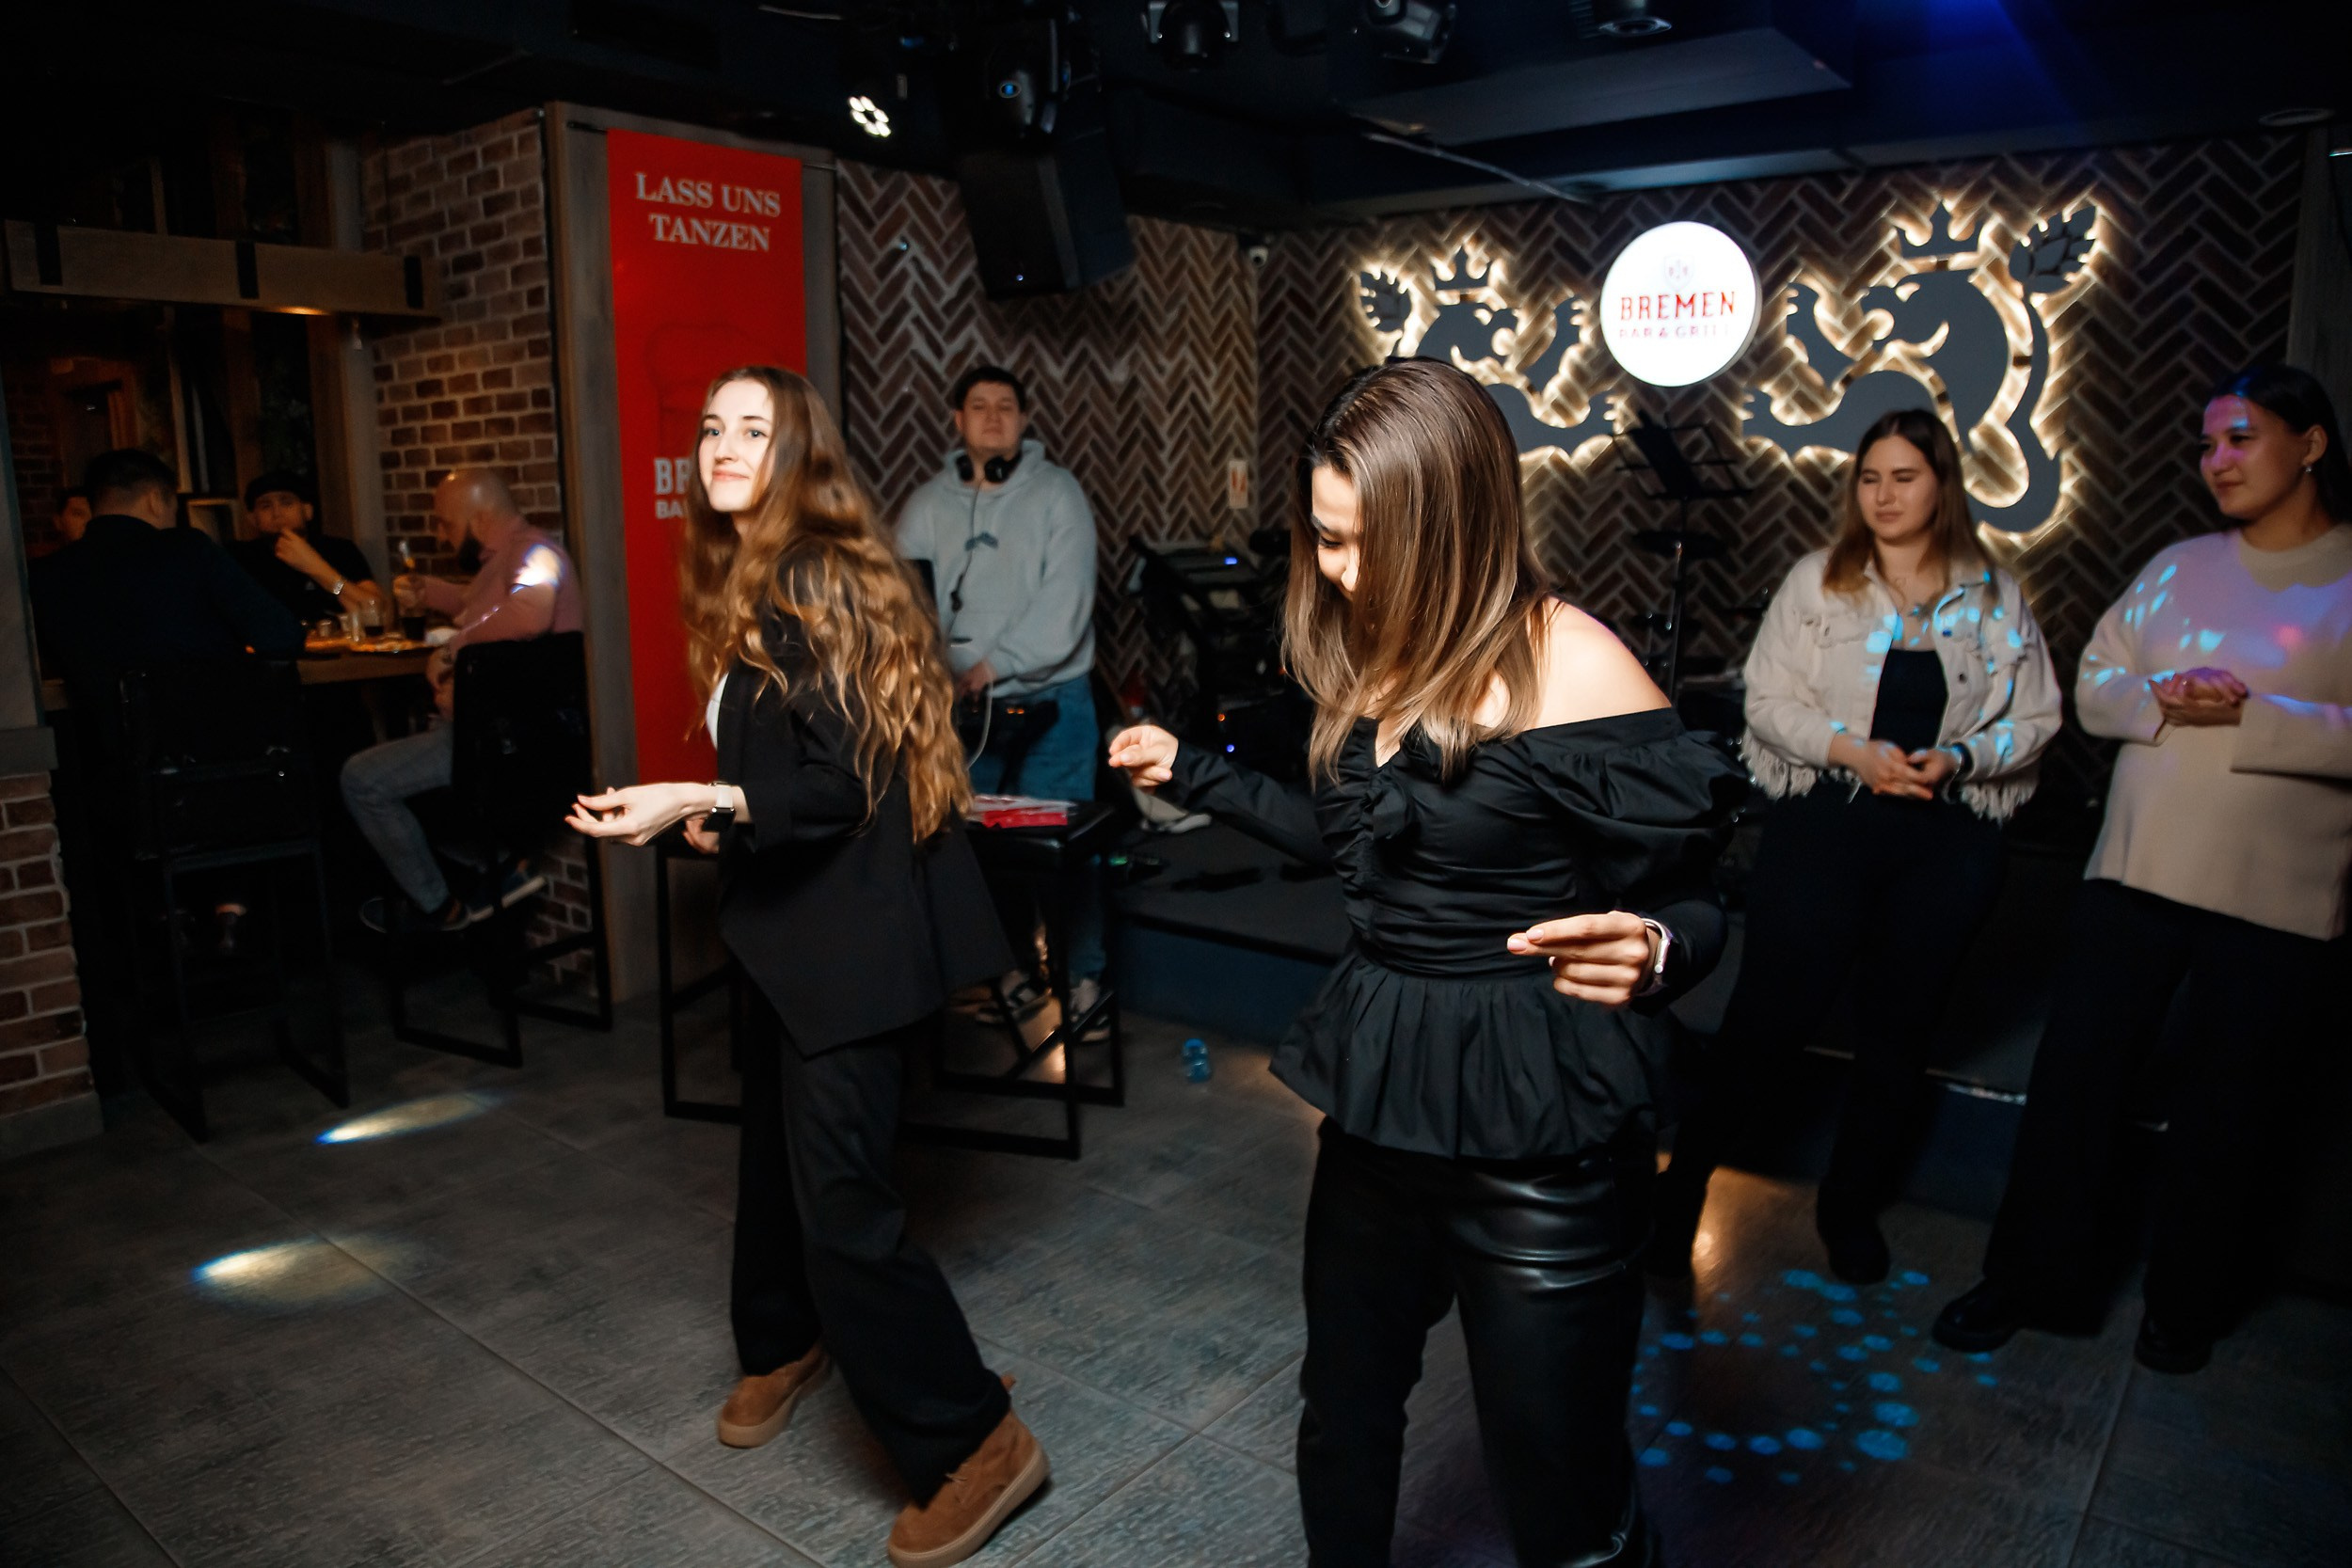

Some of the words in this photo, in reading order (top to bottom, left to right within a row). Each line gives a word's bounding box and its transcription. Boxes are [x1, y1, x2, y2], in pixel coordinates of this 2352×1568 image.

[635, 172, 713, 209] LASS
[722, 184, 781, 217] UNS
[648, 213, 771, 252] TANZEN
[1619, 291, 1736, 321] BREMEN
